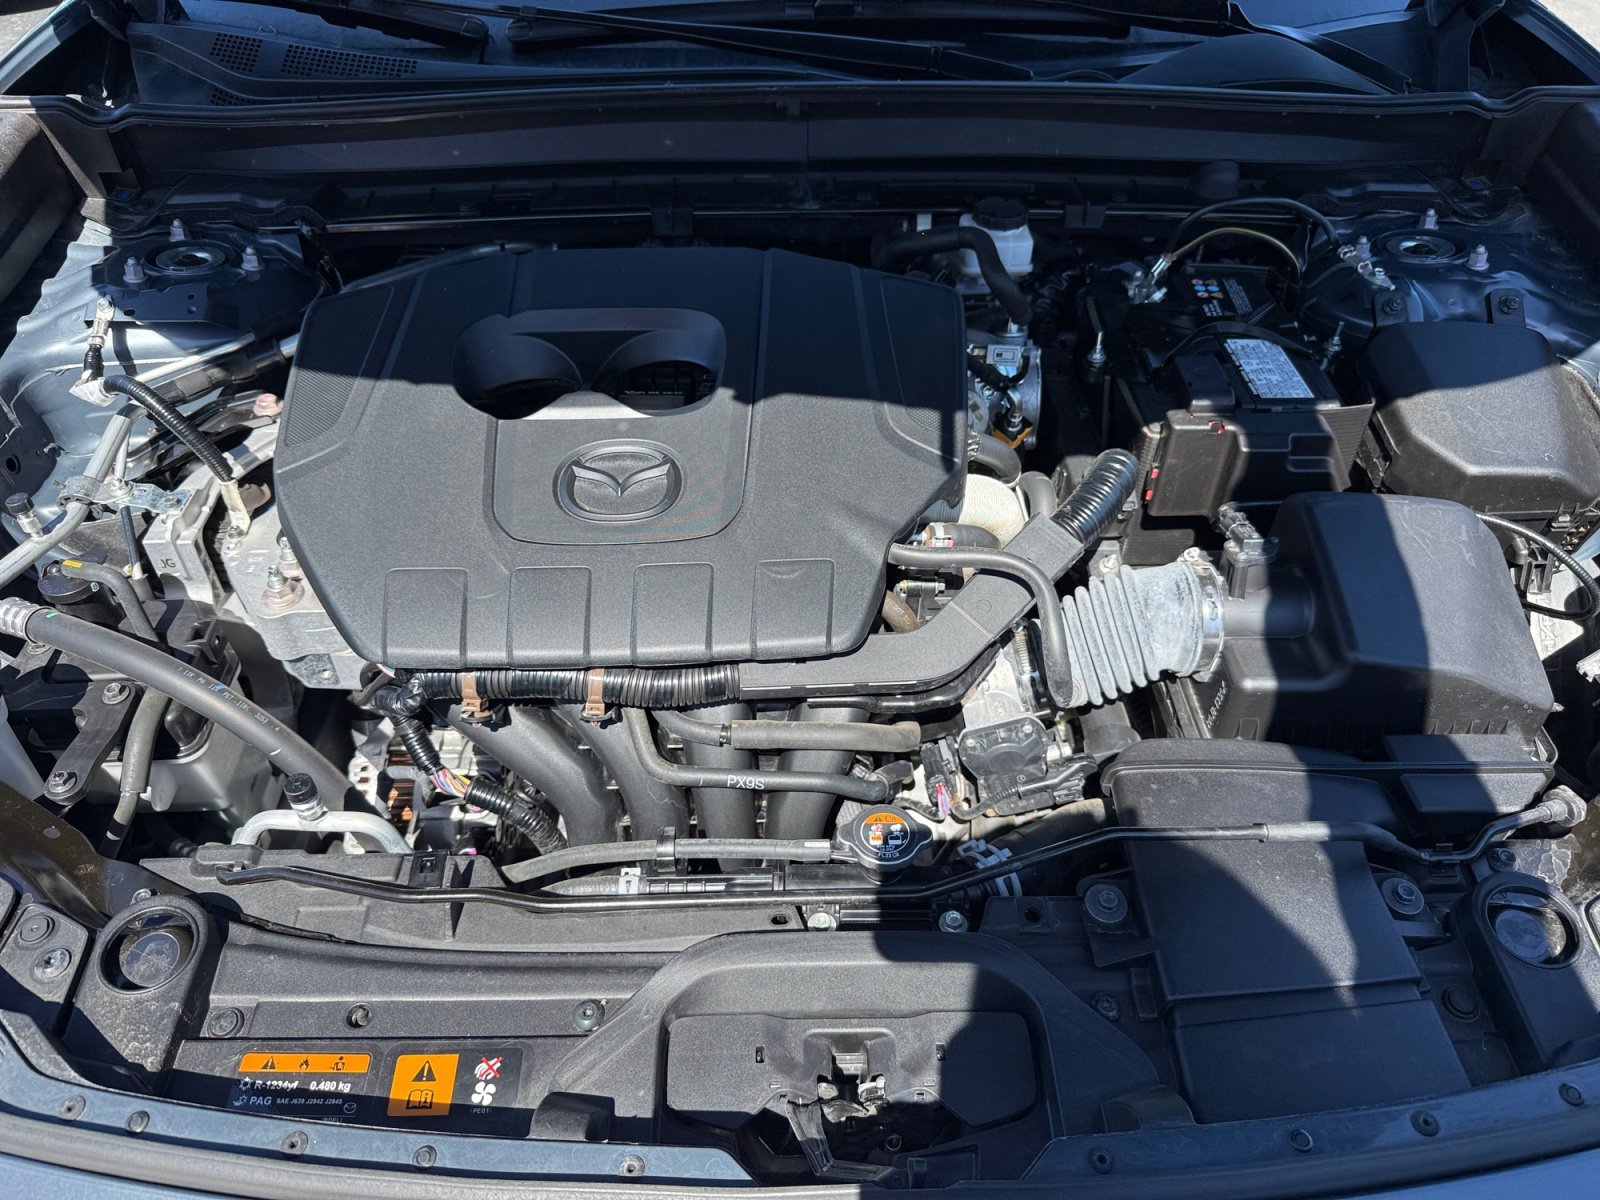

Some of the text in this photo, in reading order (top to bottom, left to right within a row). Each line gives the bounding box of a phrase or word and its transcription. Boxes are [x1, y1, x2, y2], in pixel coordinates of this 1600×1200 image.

[727, 774, 765, 790] PX9S
[254, 1080, 352, 1093] R-1234yf 0.480 kg
[249, 1096, 272, 1105] PAG
